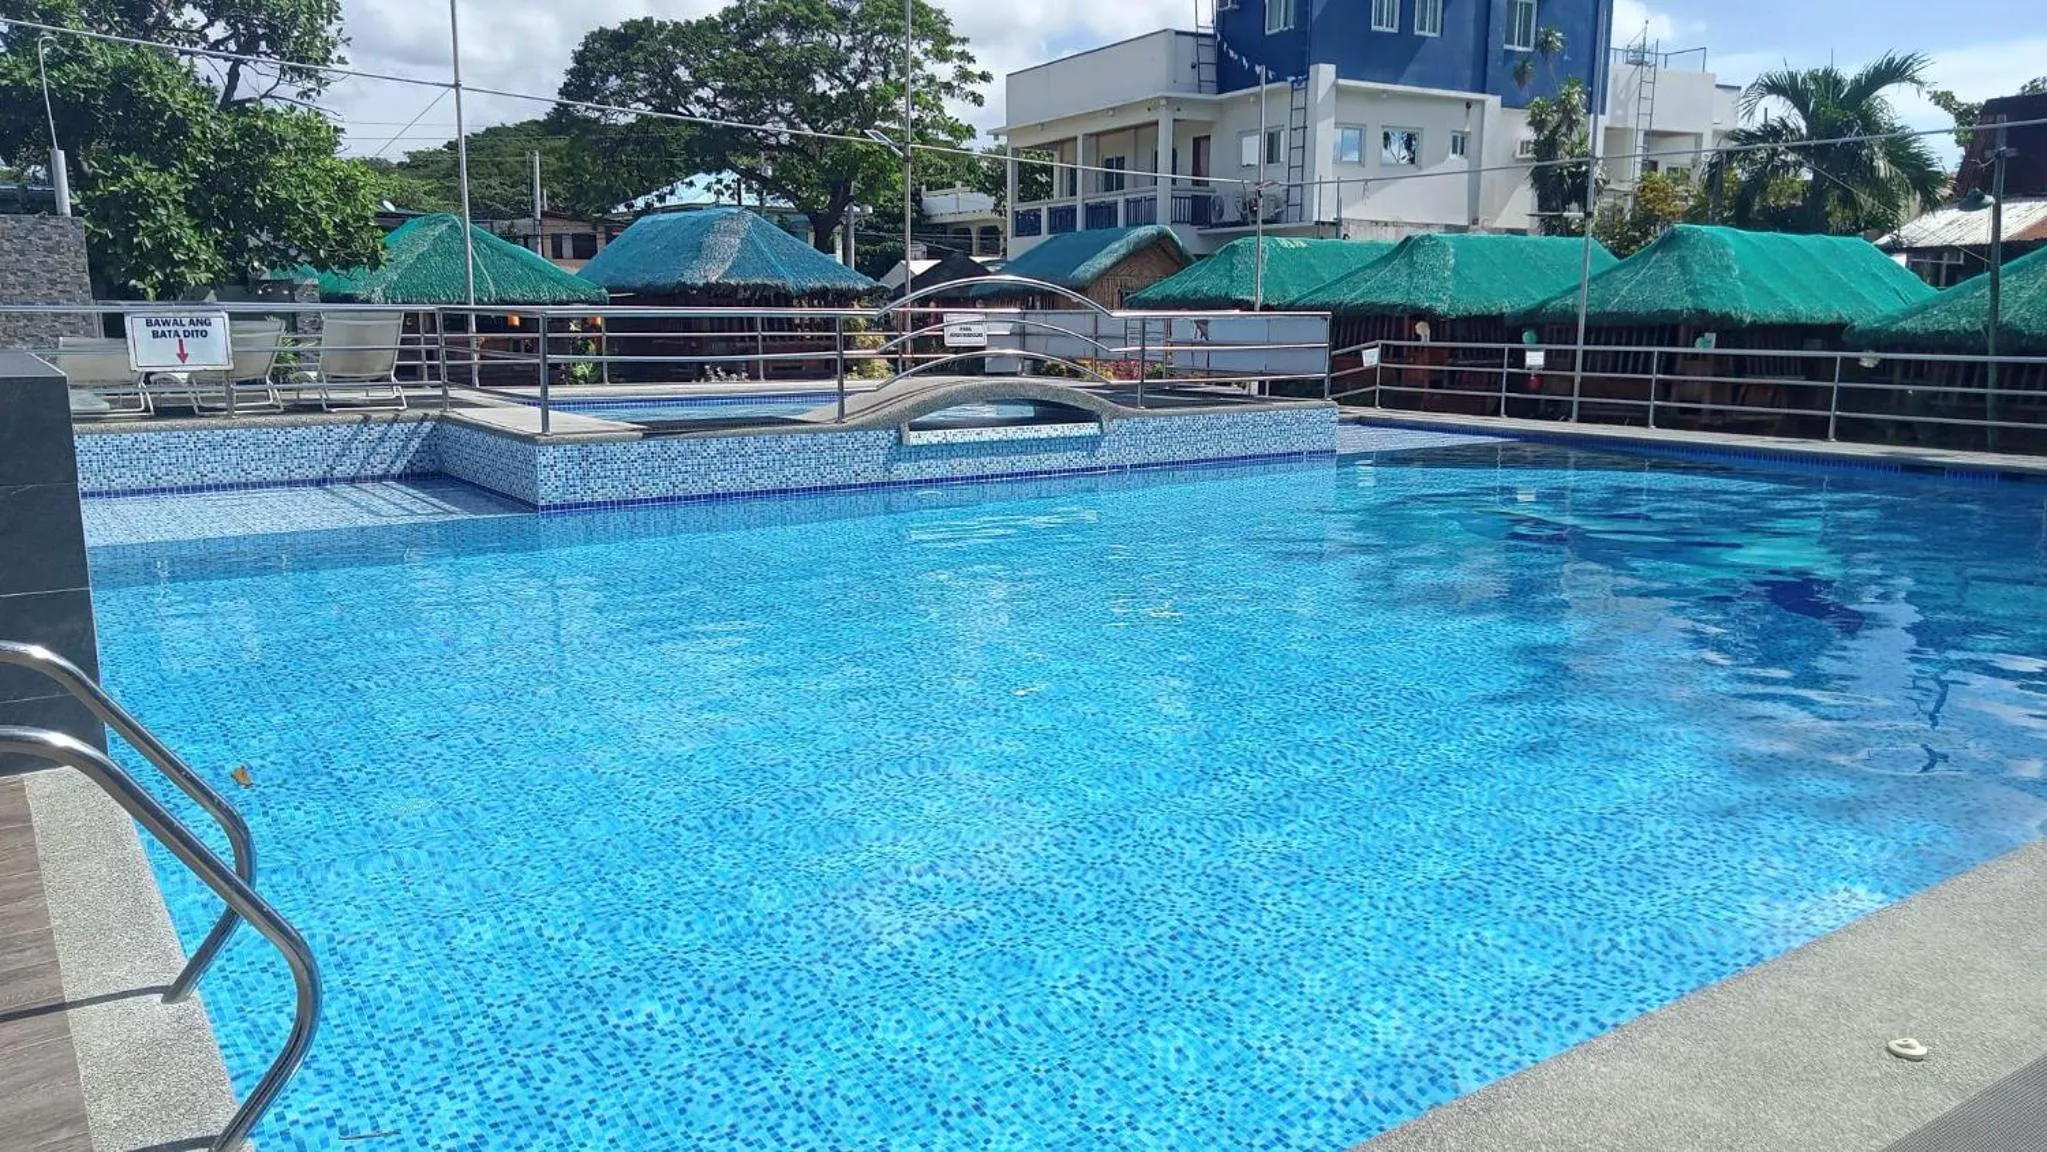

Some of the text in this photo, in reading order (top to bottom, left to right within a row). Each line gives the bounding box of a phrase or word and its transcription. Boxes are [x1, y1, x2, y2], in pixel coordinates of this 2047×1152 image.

[145, 318, 212, 327] BAWAL ANG
[151, 330, 208, 339] BATA DITO
